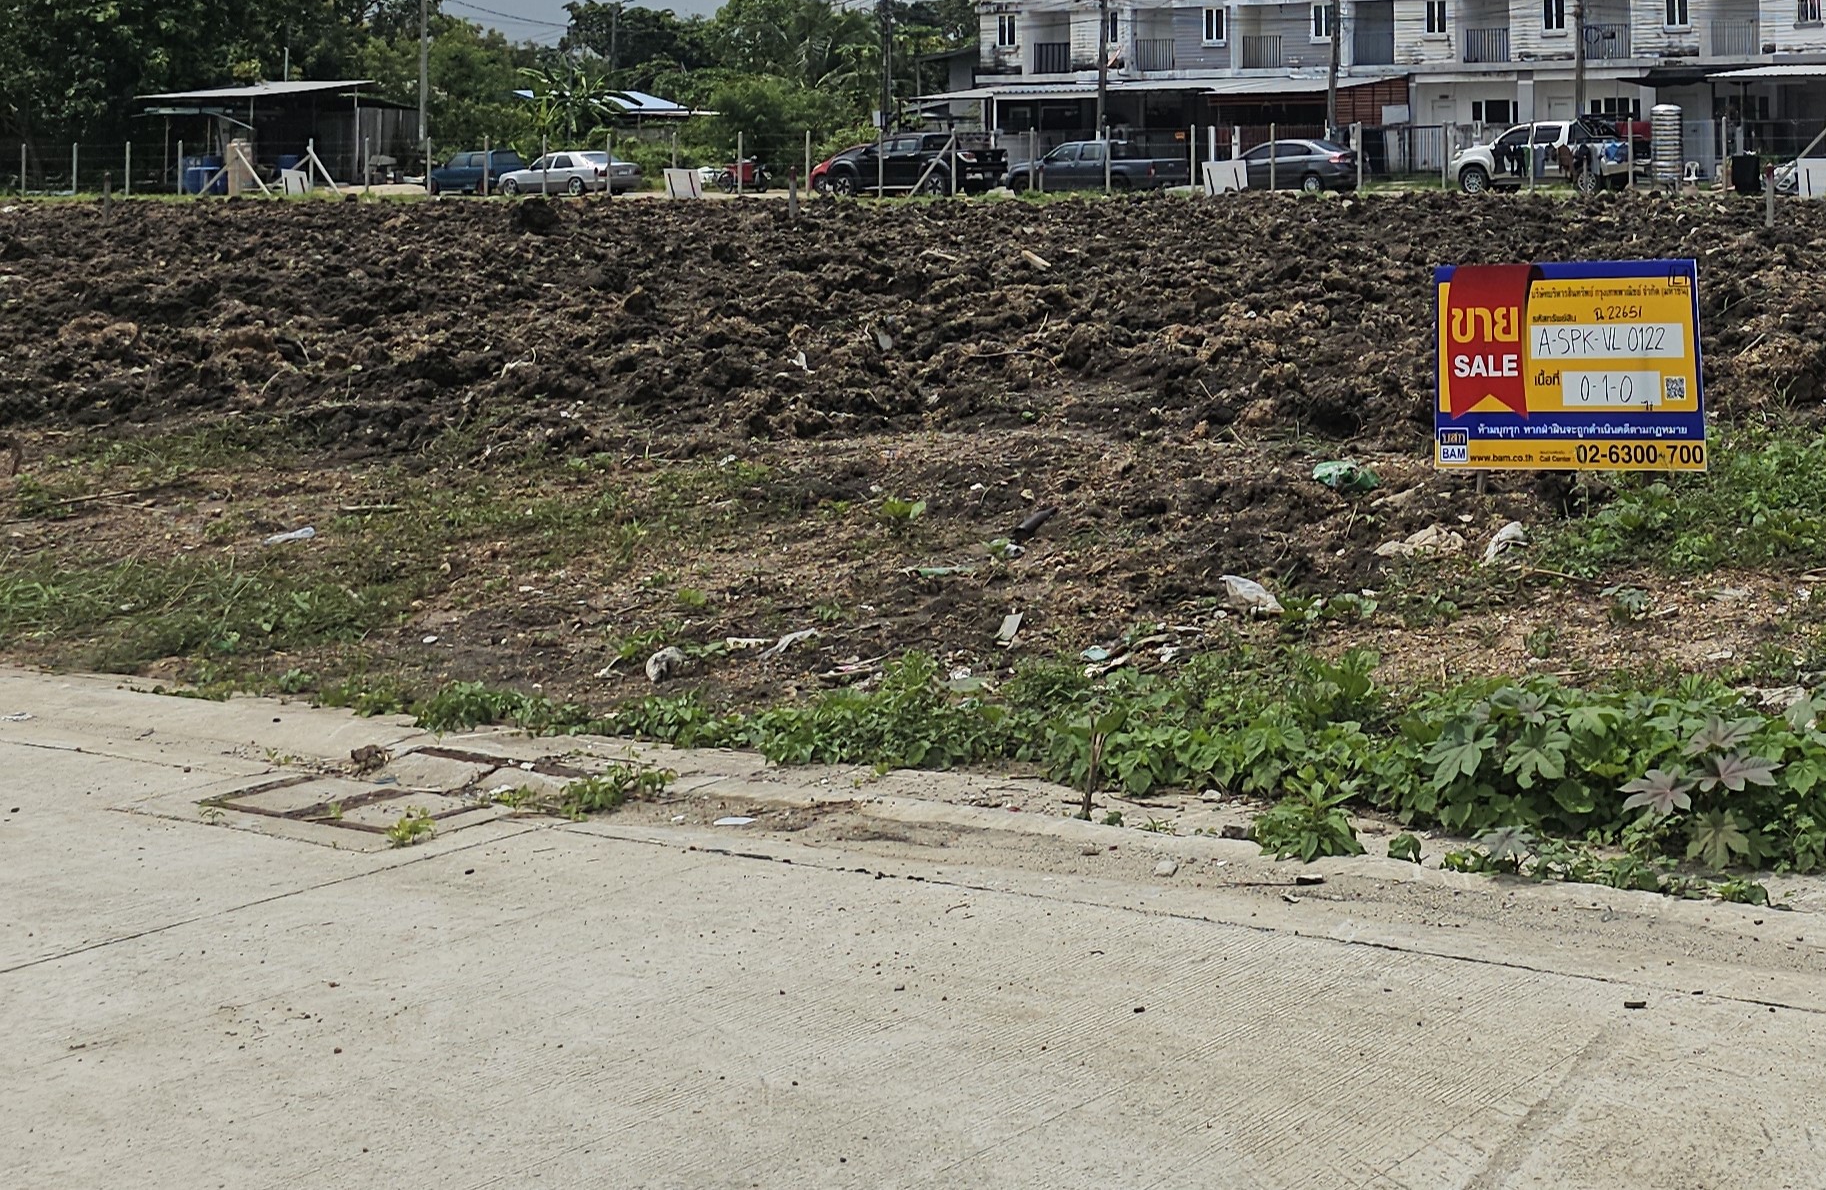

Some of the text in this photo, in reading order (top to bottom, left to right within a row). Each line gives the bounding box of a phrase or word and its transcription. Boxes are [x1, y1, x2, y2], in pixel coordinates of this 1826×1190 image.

[1607, 305, 1642, 320] 22651
[1452, 307, 1518, 343] ขาย
[1538, 326, 1666, 356] A-SPK-VL 0122
[1454, 354, 1518, 378] SALE
[1534, 369, 1560, 386] เนื้อที่
[1441, 431, 1466, 444] บสก
[1478, 423, 1520, 438] ห้ามบุกรุก
[1442, 447, 1466, 460] BAM
[1470, 454, 1533, 463] www.bam.co.th
